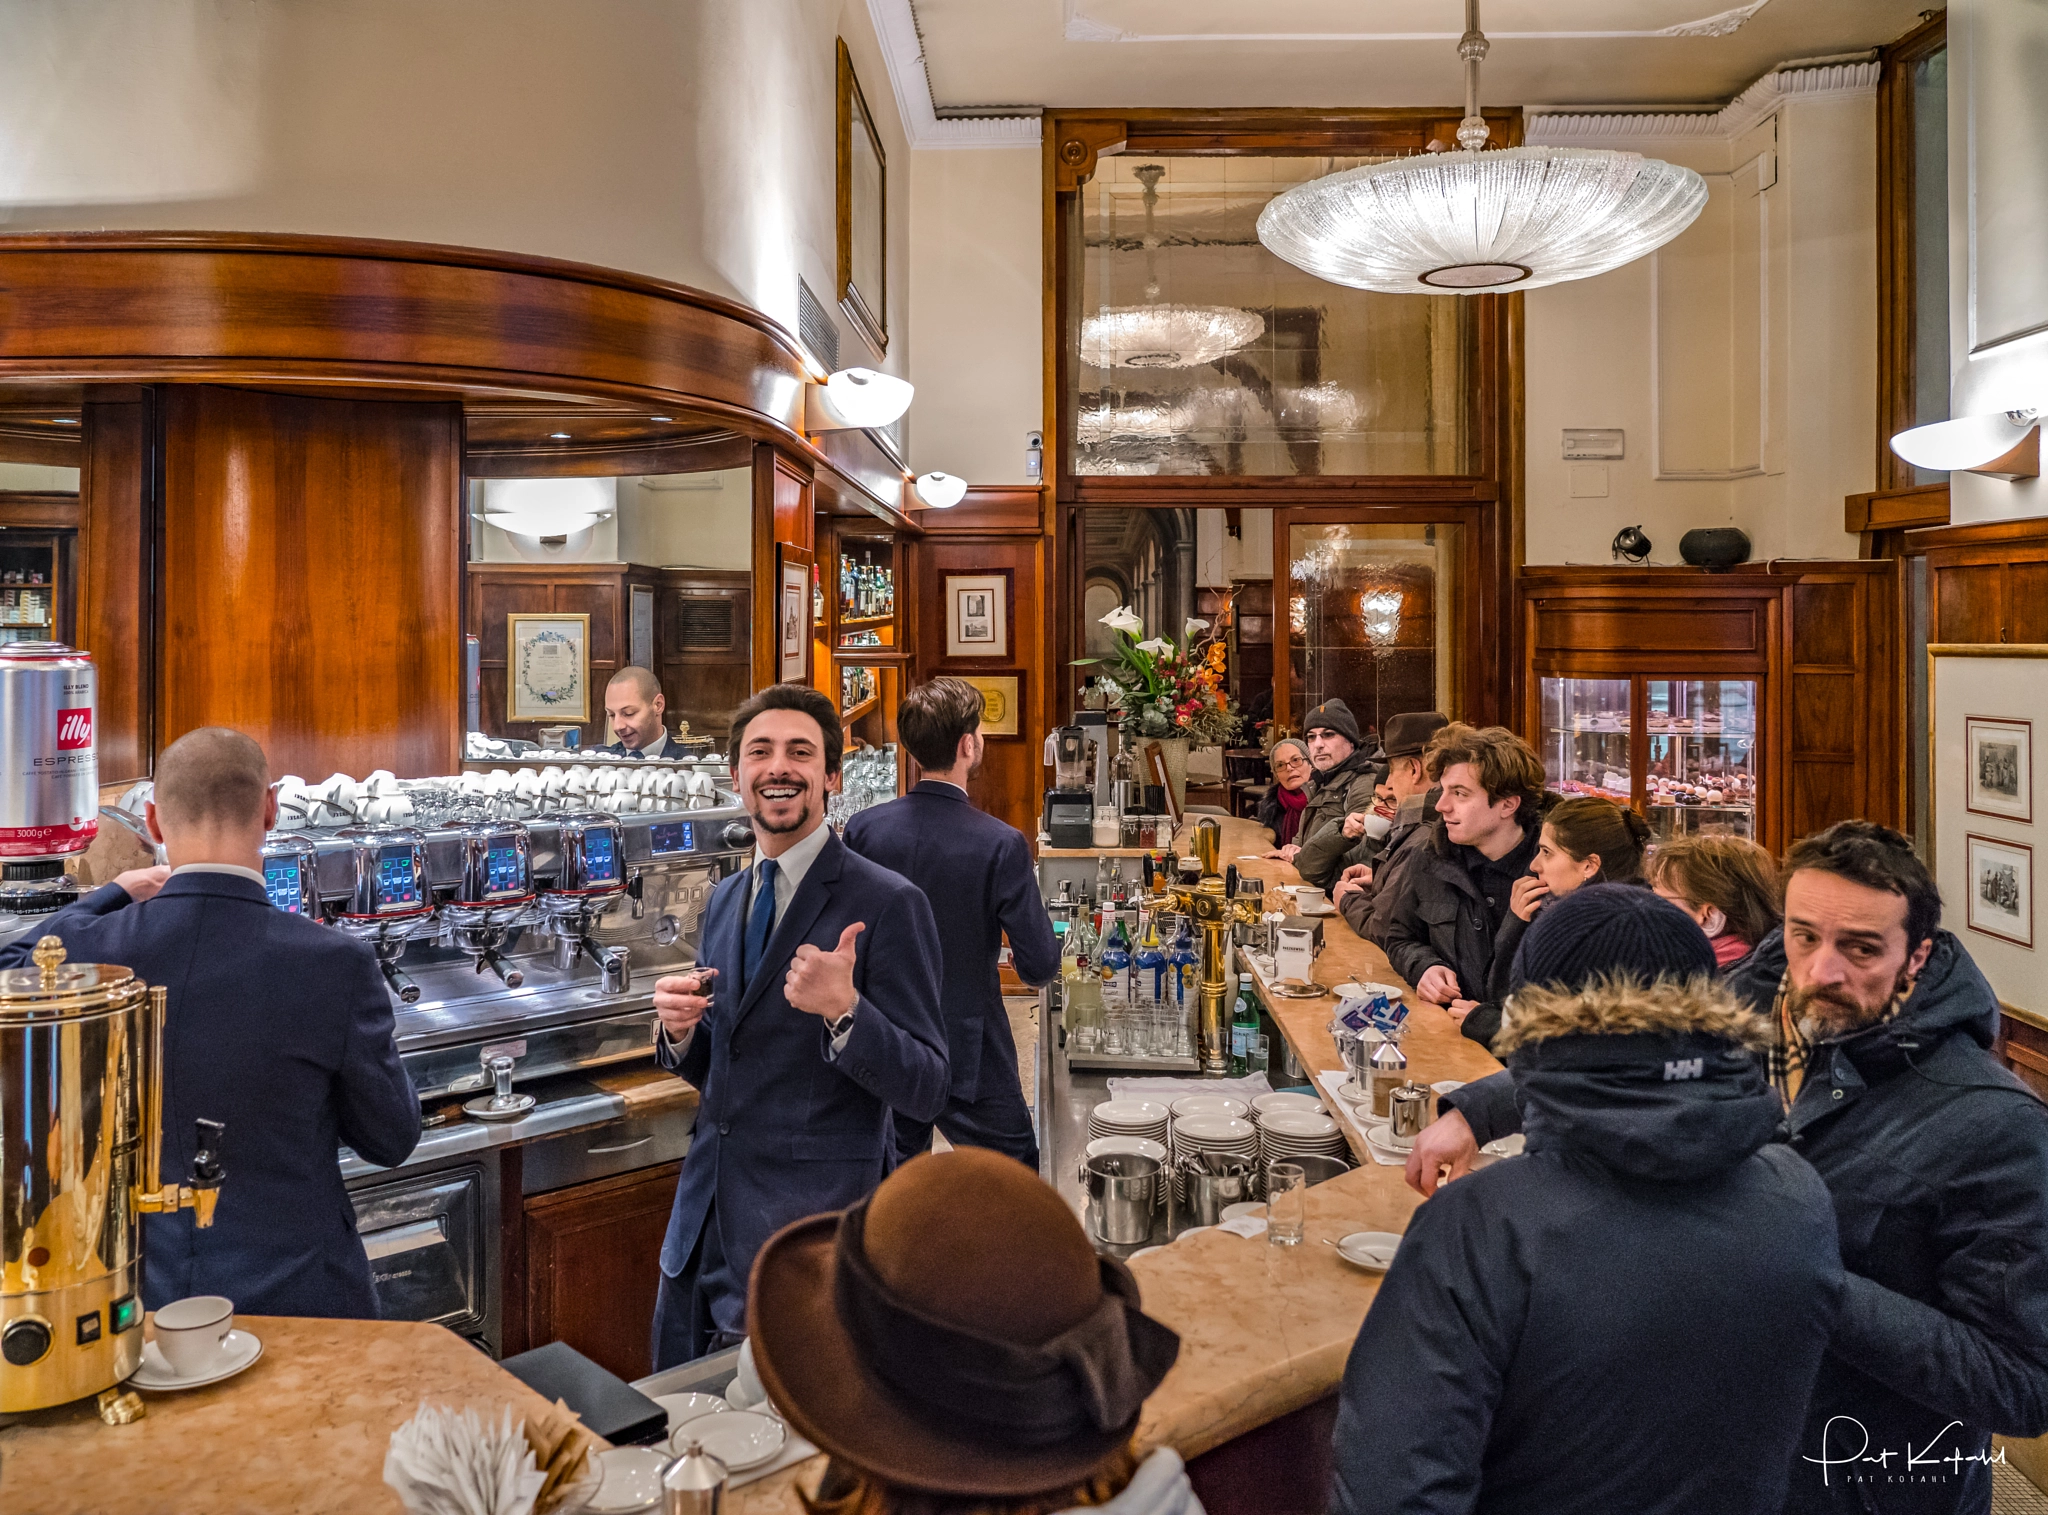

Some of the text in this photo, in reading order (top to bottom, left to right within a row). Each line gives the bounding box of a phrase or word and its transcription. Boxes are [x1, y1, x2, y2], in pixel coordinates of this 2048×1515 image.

[60, 714, 91, 745] illy
[33, 752, 98, 767] ESPRESS
[1663, 1057, 1704, 1081] HH
